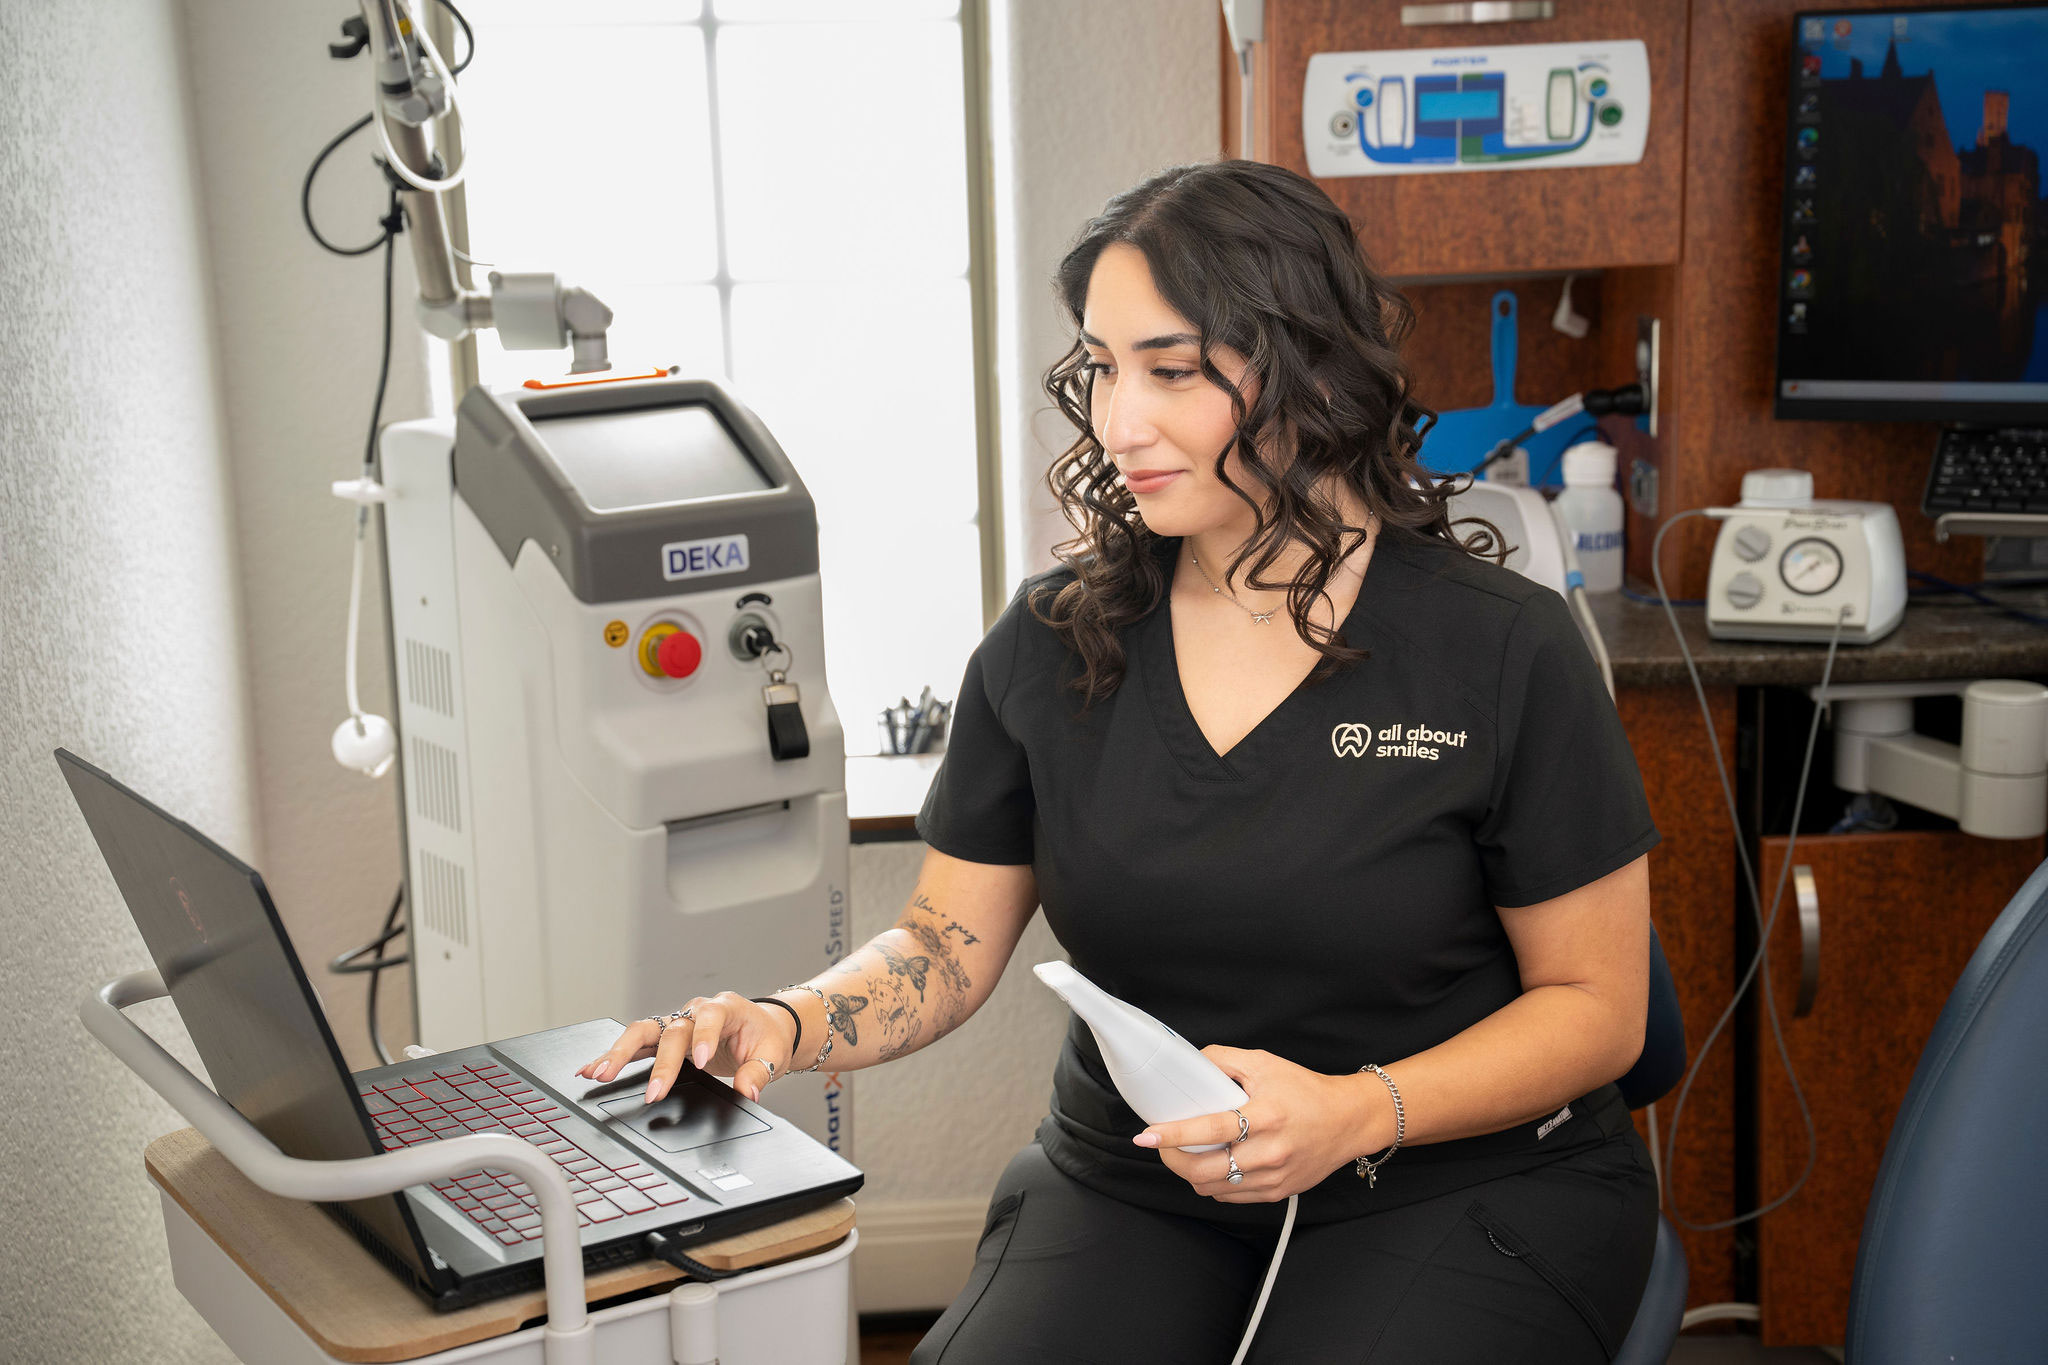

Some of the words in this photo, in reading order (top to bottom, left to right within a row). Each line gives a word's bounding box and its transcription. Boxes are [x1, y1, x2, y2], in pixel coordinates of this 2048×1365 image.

[669, 541, 744, 574] DEKA
[1378, 723, 1402, 741] all
[1406, 723, 1468, 748] about
[1376, 741, 1440, 761] smiles
[945, 921, 981, 946] grey
